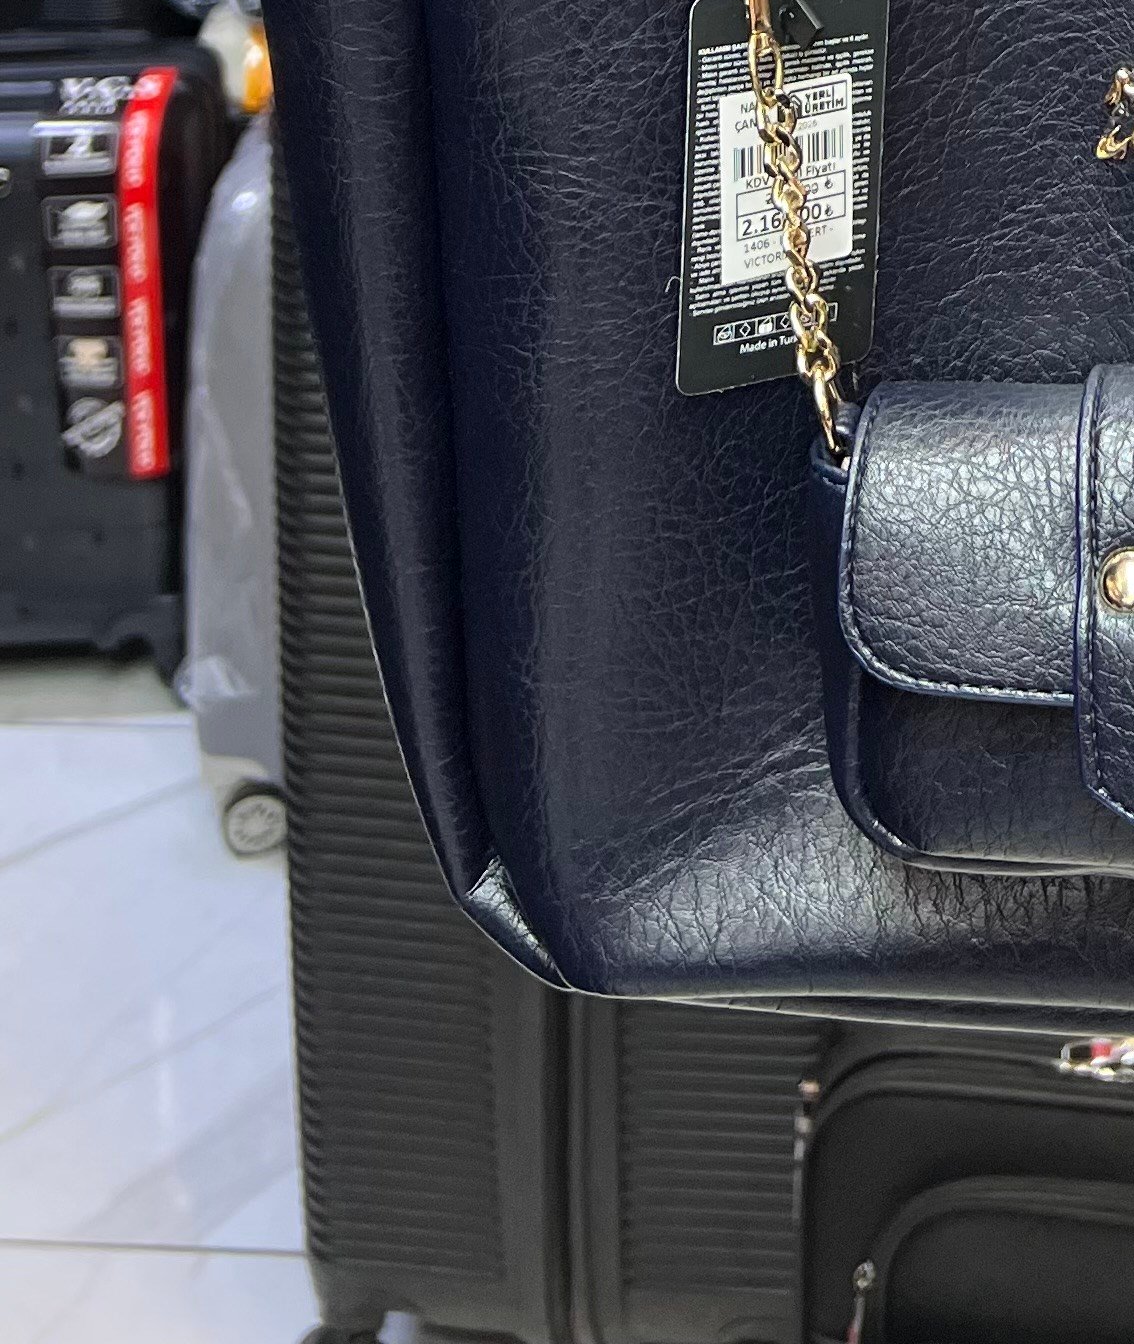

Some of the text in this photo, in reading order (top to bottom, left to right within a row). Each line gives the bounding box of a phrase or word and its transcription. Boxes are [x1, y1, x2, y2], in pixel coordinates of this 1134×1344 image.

[746, 176, 770, 189] KDV
[744, 239, 770, 254] 1406
[739, 339, 767, 354] Made
[768, 338, 778, 348] in
